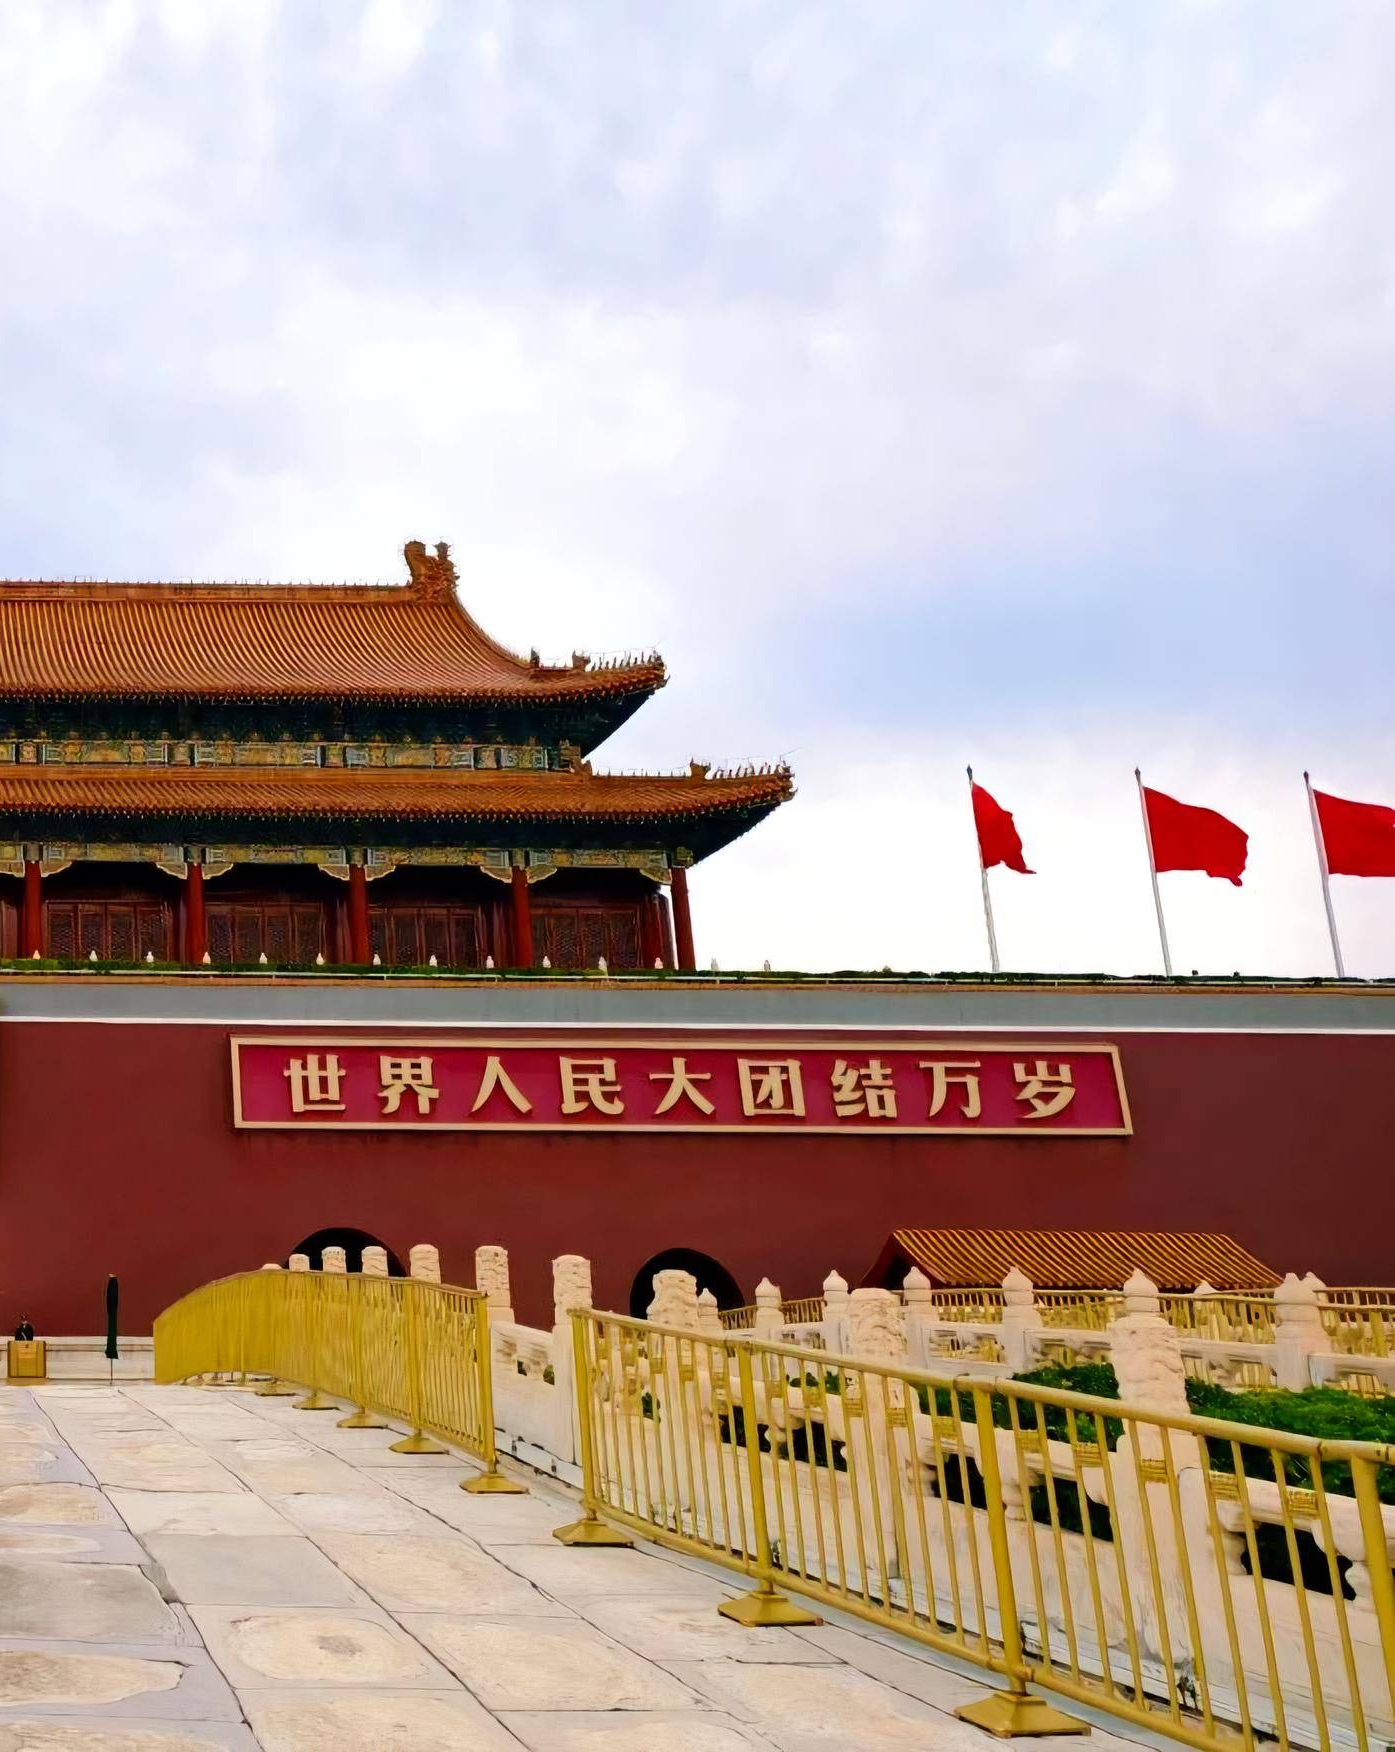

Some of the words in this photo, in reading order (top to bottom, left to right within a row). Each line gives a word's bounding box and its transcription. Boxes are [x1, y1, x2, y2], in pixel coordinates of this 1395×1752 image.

[283, 1053, 1077, 1120] 世界人民大团结万岁
